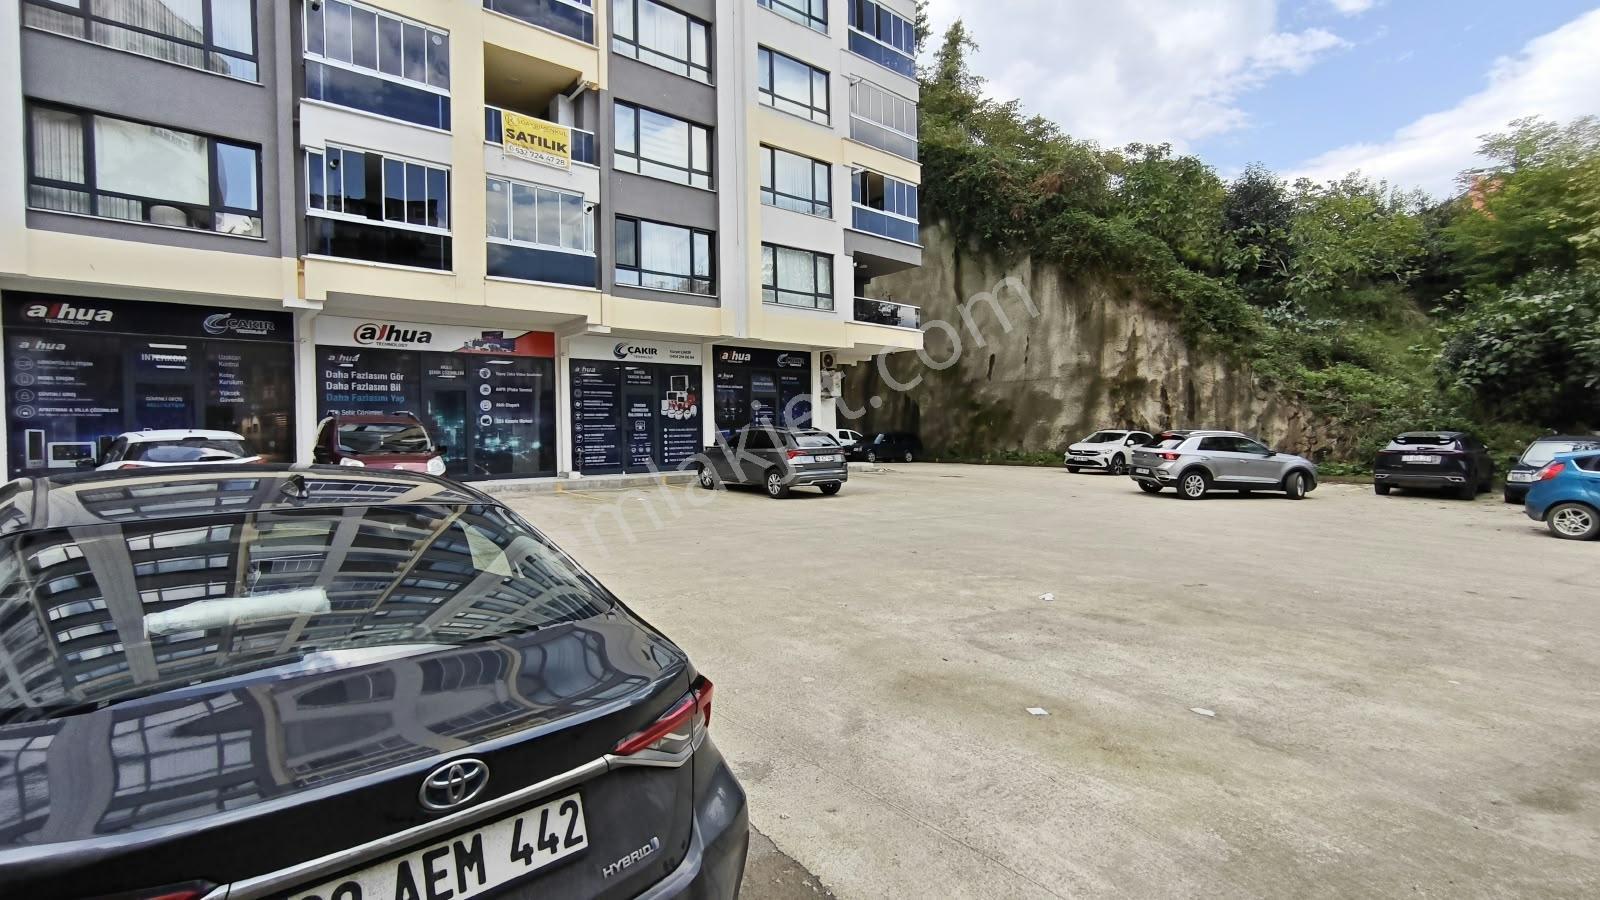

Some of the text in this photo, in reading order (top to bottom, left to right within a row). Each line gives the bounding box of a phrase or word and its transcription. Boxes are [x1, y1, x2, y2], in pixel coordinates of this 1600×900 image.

[506, 128, 568, 154] SATILIK
[19, 341, 66, 350] ahua
[628, 346, 658, 356] ÇAKIR
[326, 370, 404, 380] Daha Fazlasını Gör
[326, 382, 400, 392] Daha Fazlasını Bil
[326, 393, 349, 402] Daha
[390, 394, 405, 404] Yap
[394, 800, 584, 900] AEM 442
[602, 845, 654, 880] HYBRID
